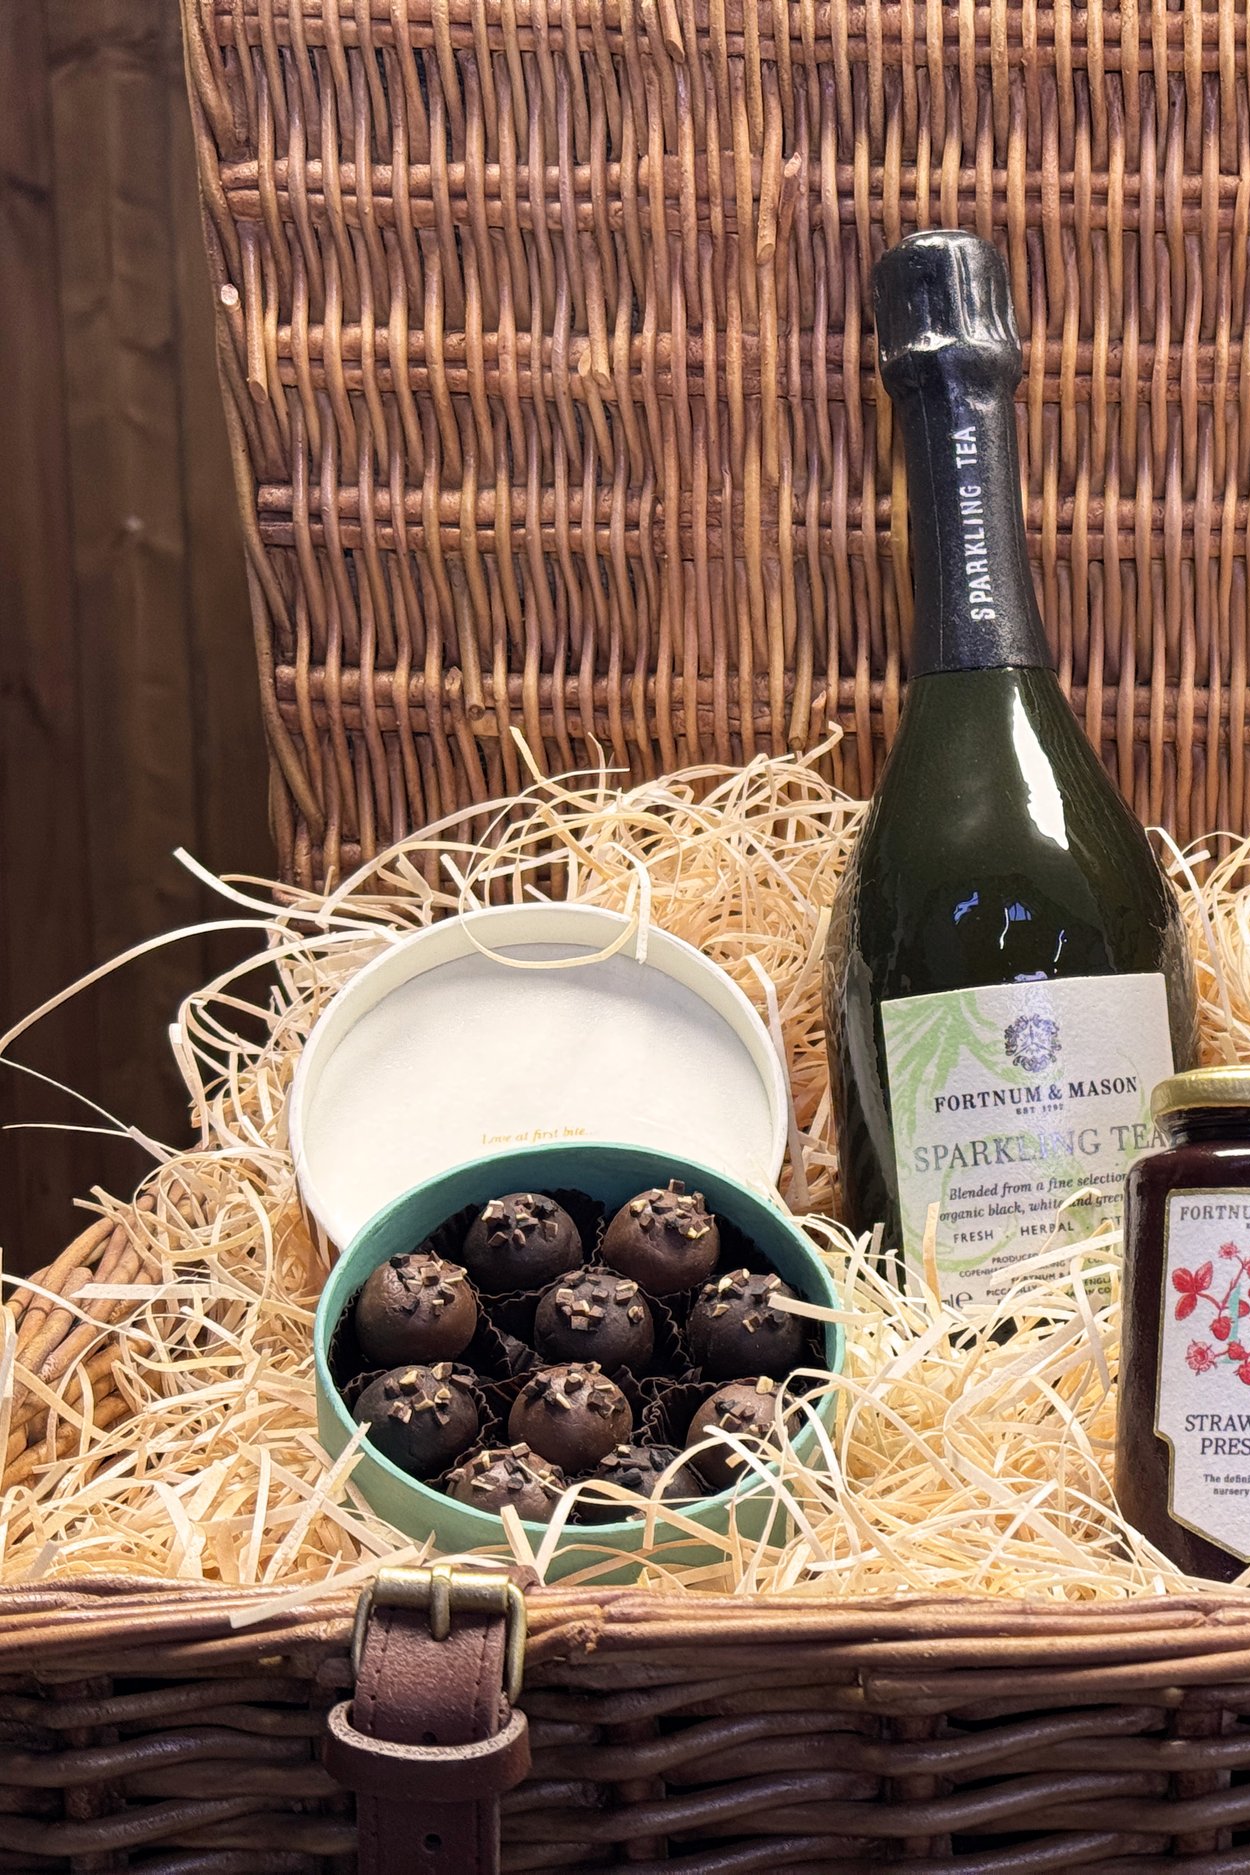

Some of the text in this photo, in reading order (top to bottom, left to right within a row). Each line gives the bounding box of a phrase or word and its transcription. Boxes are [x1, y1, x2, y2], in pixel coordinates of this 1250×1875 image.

[951, 425, 996, 622] SPARKLING TEA
[934, 1076, 1139, 1113] FORTNUM & MASON
[914, 1123, 1167, 1173] SPARKLING TEA
[950, 1183, 999, 1201] Blended
[1000, 1182, 1032, 1198] from
[1036, 1181, 1044, 1191] a
[1048, 1176, 1073, 1193] fine
[940, 1208, 985, 1224] organic
[988, 1200, 1026, 1217] black,
[953, 1220, 1075, 1244] FRESH HERBAL
[1203, 1473, 1221, 1484] The
[1213, 1487, 1250, 1498] nursery
